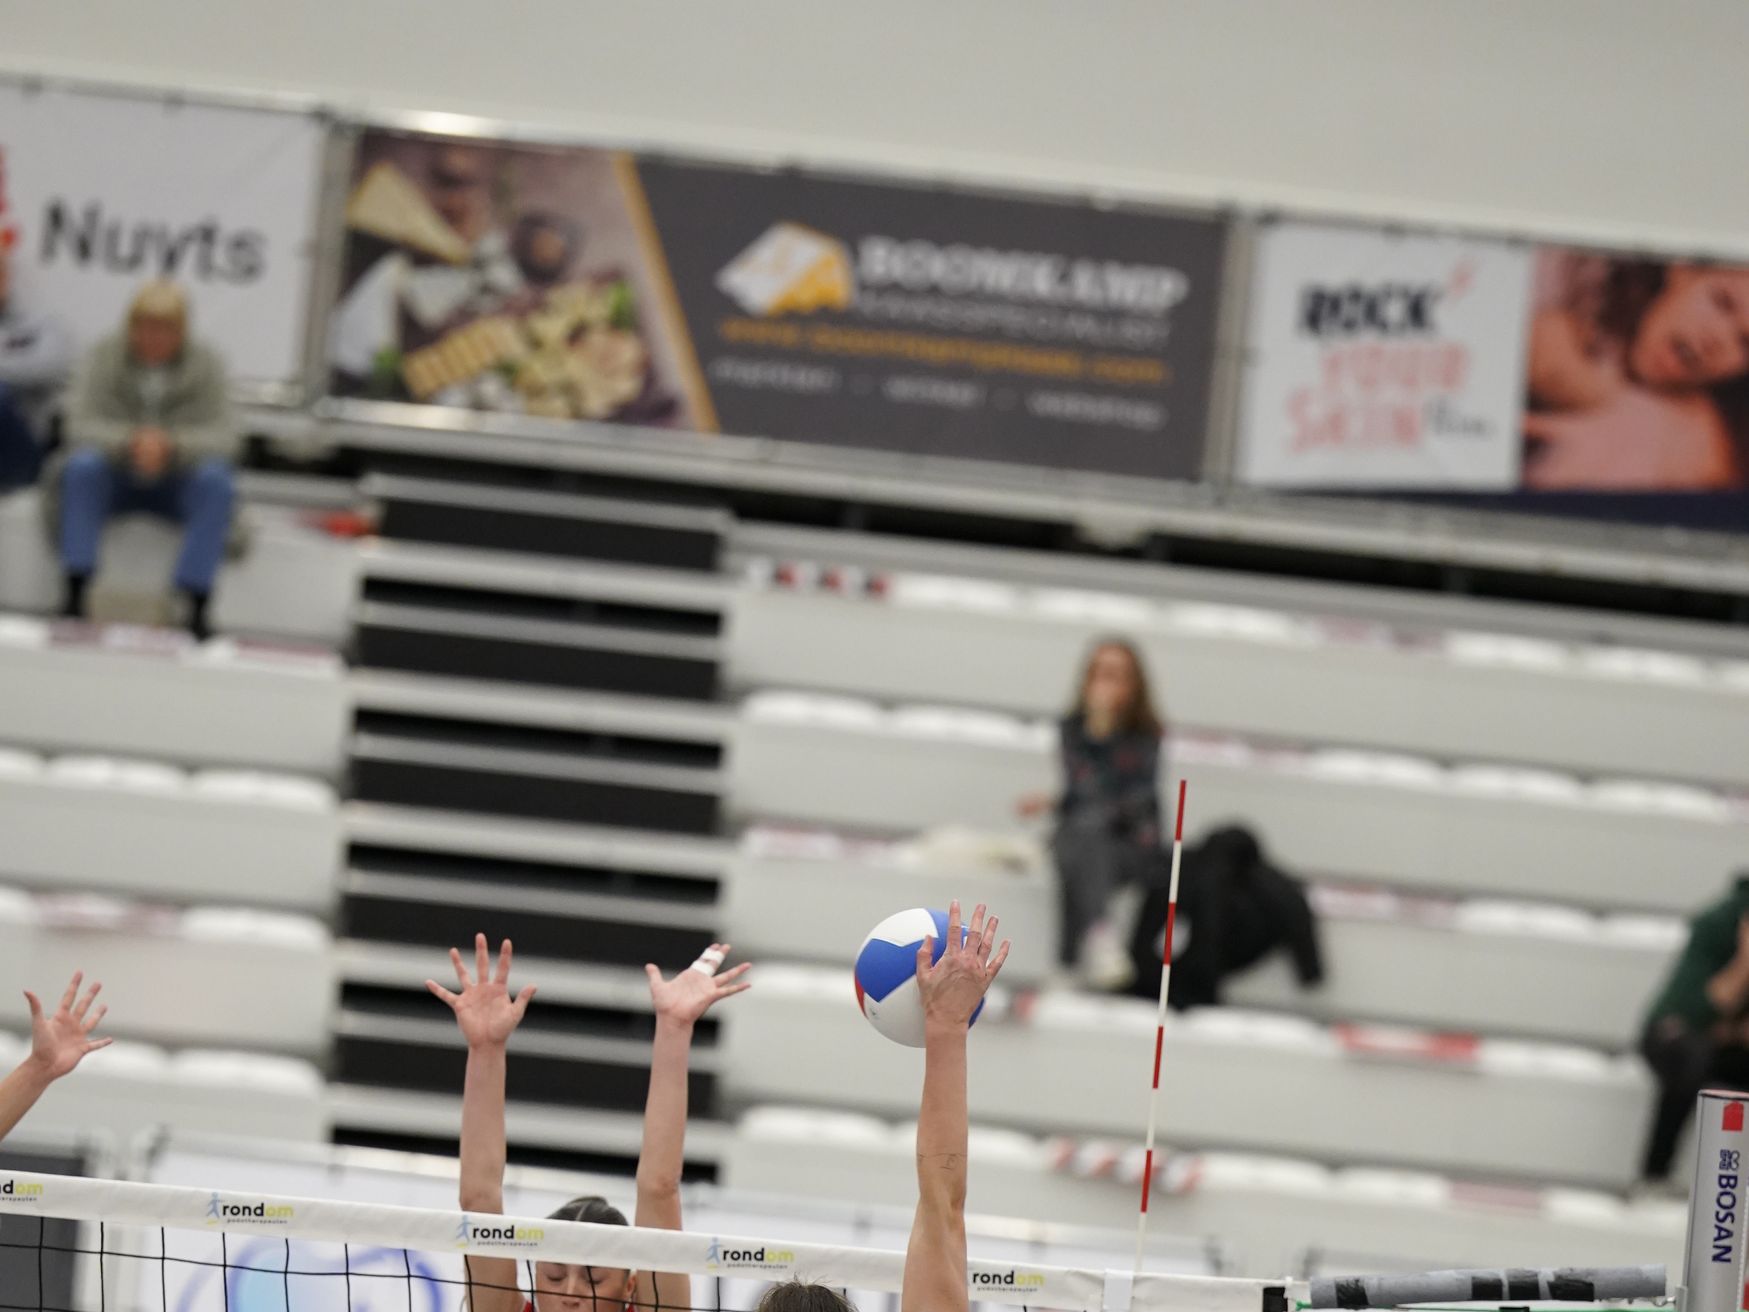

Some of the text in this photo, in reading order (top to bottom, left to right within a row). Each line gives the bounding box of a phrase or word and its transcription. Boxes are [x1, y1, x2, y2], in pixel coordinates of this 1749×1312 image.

[222, 1203, 294, 1218] rondom
[1711, 1174, 1738, 1264] BOSAN
[472, 1225, 544, 1241] rondom
[722, 1247, 794, 1263] rondom
[972, 1270, 1045, 1286] rondom
